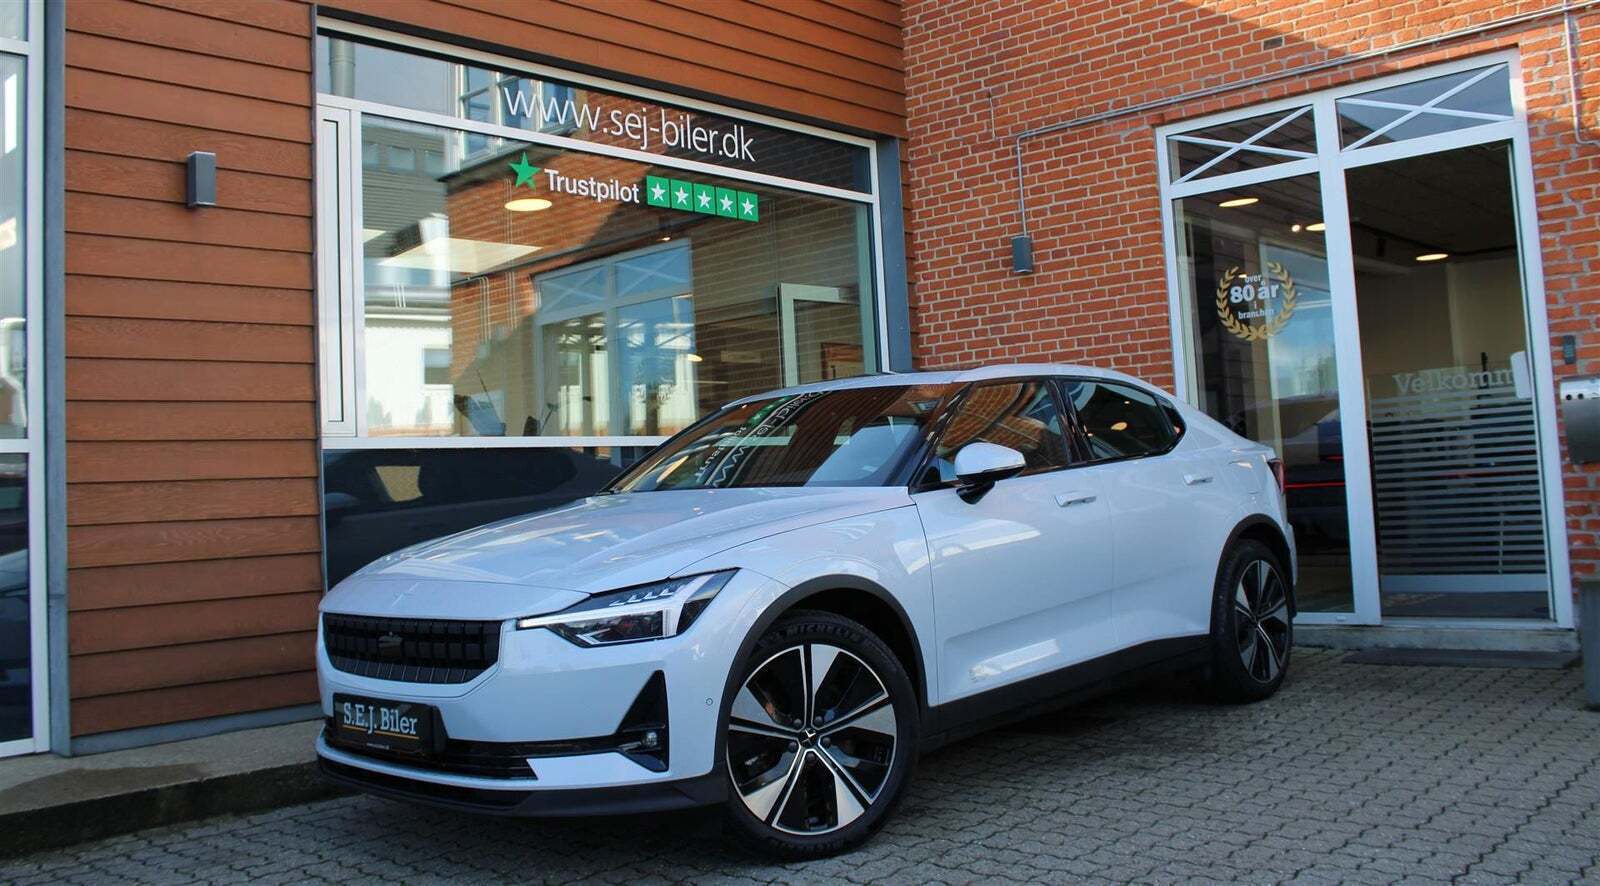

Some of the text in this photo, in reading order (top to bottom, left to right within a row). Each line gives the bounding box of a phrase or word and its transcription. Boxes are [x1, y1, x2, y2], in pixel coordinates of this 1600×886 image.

[504, 87, 756, 163] www.sej-biler.dk
[544, 167, 640, 203] Trustpilot
[1230, 280, 1279, 304] 80 år
[343, 702, 418, 736] S.E.J. Biler
